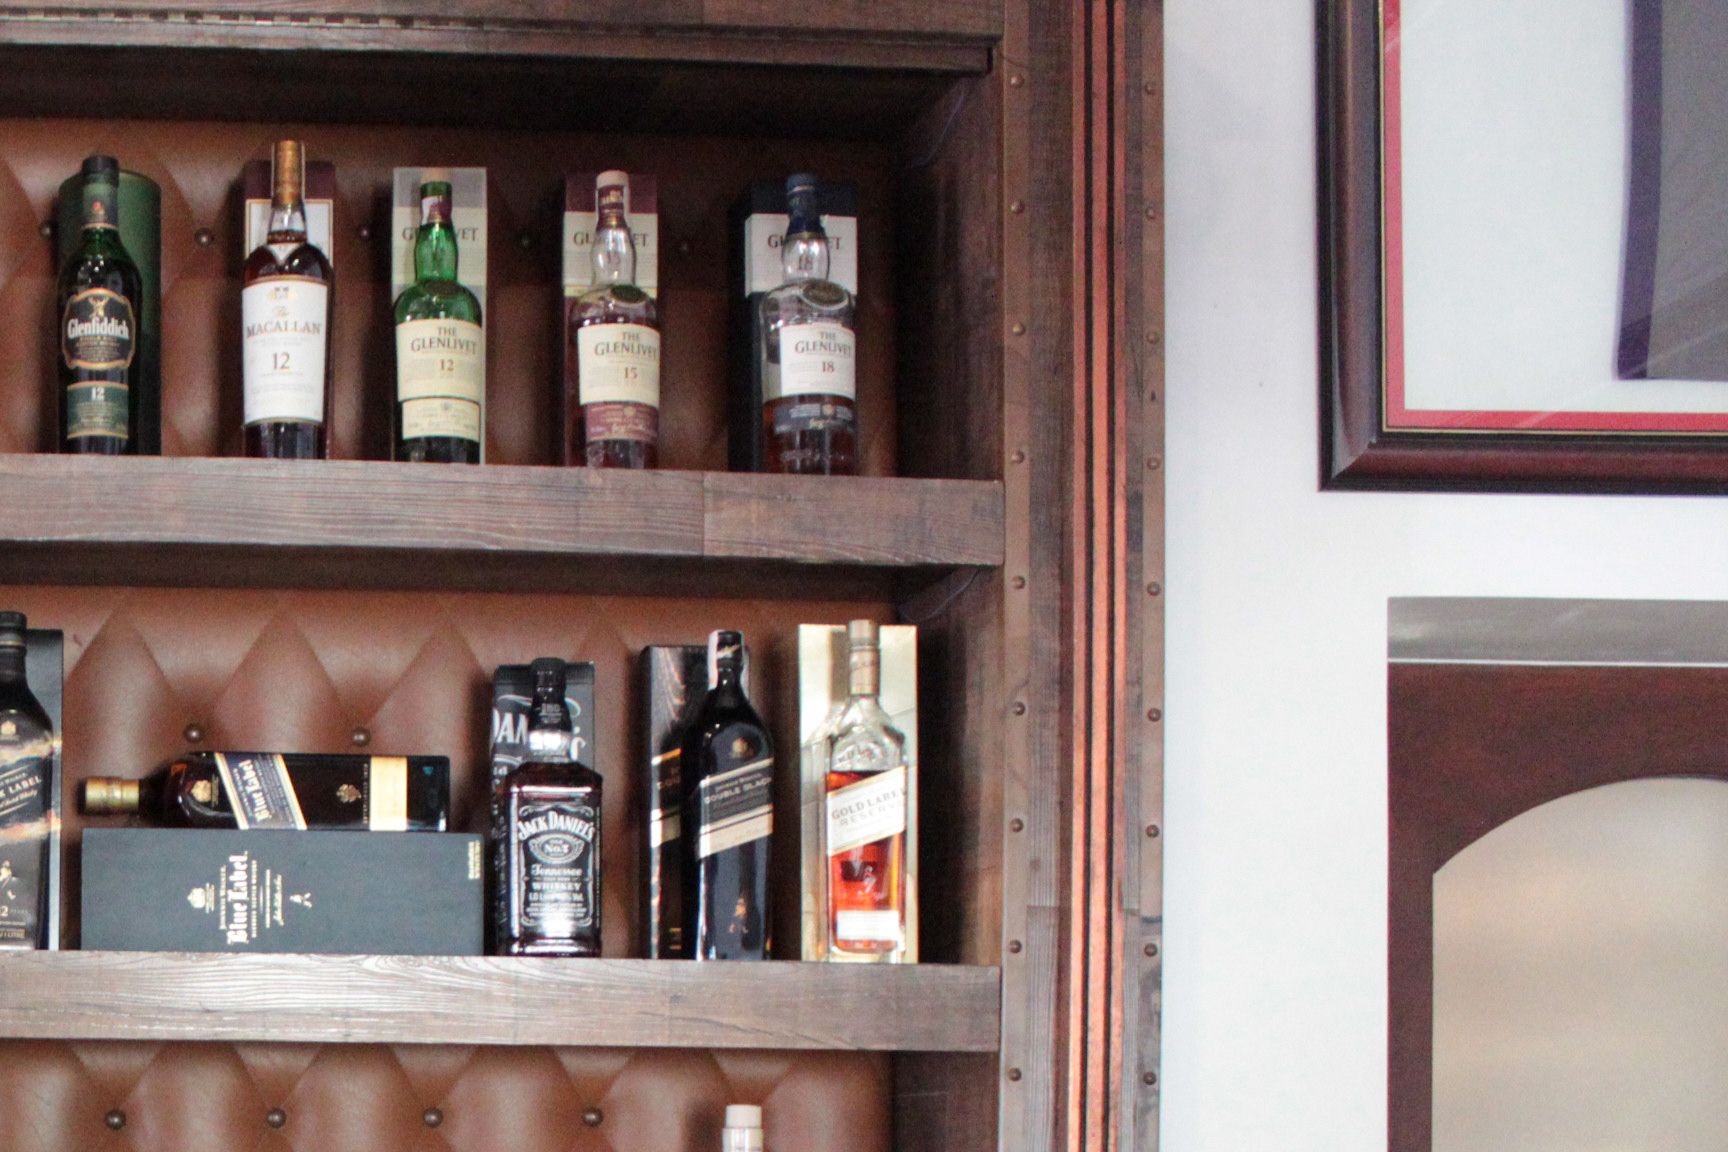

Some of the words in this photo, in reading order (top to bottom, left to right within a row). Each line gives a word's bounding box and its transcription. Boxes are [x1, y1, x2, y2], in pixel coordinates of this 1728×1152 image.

[67, 316, 130, 340] Glenfiddich
[246, 320, 321, 339] MACALLAN
[437, 326, 457, 337] THE
[410, 337, 477, 355] GLENLIVET
[273, 351, 290, 370] 12
[440, 359, 454, 371] 12
[821, 361, 835, 373] 18
[623, 366, 638, 379] 15
[91, 386, 105, 400] 12
[8, 775, 42, 795] LABEL
[238, 759, 263, 792] Label
[249, 791, 272, 822] Blue
[831, 800, 865, 820] GOLD
[517, 815, 548, 841] JACK
[548, 810, 596, 841] DANIEL'S
[227, 902, 250, 945] Blue
